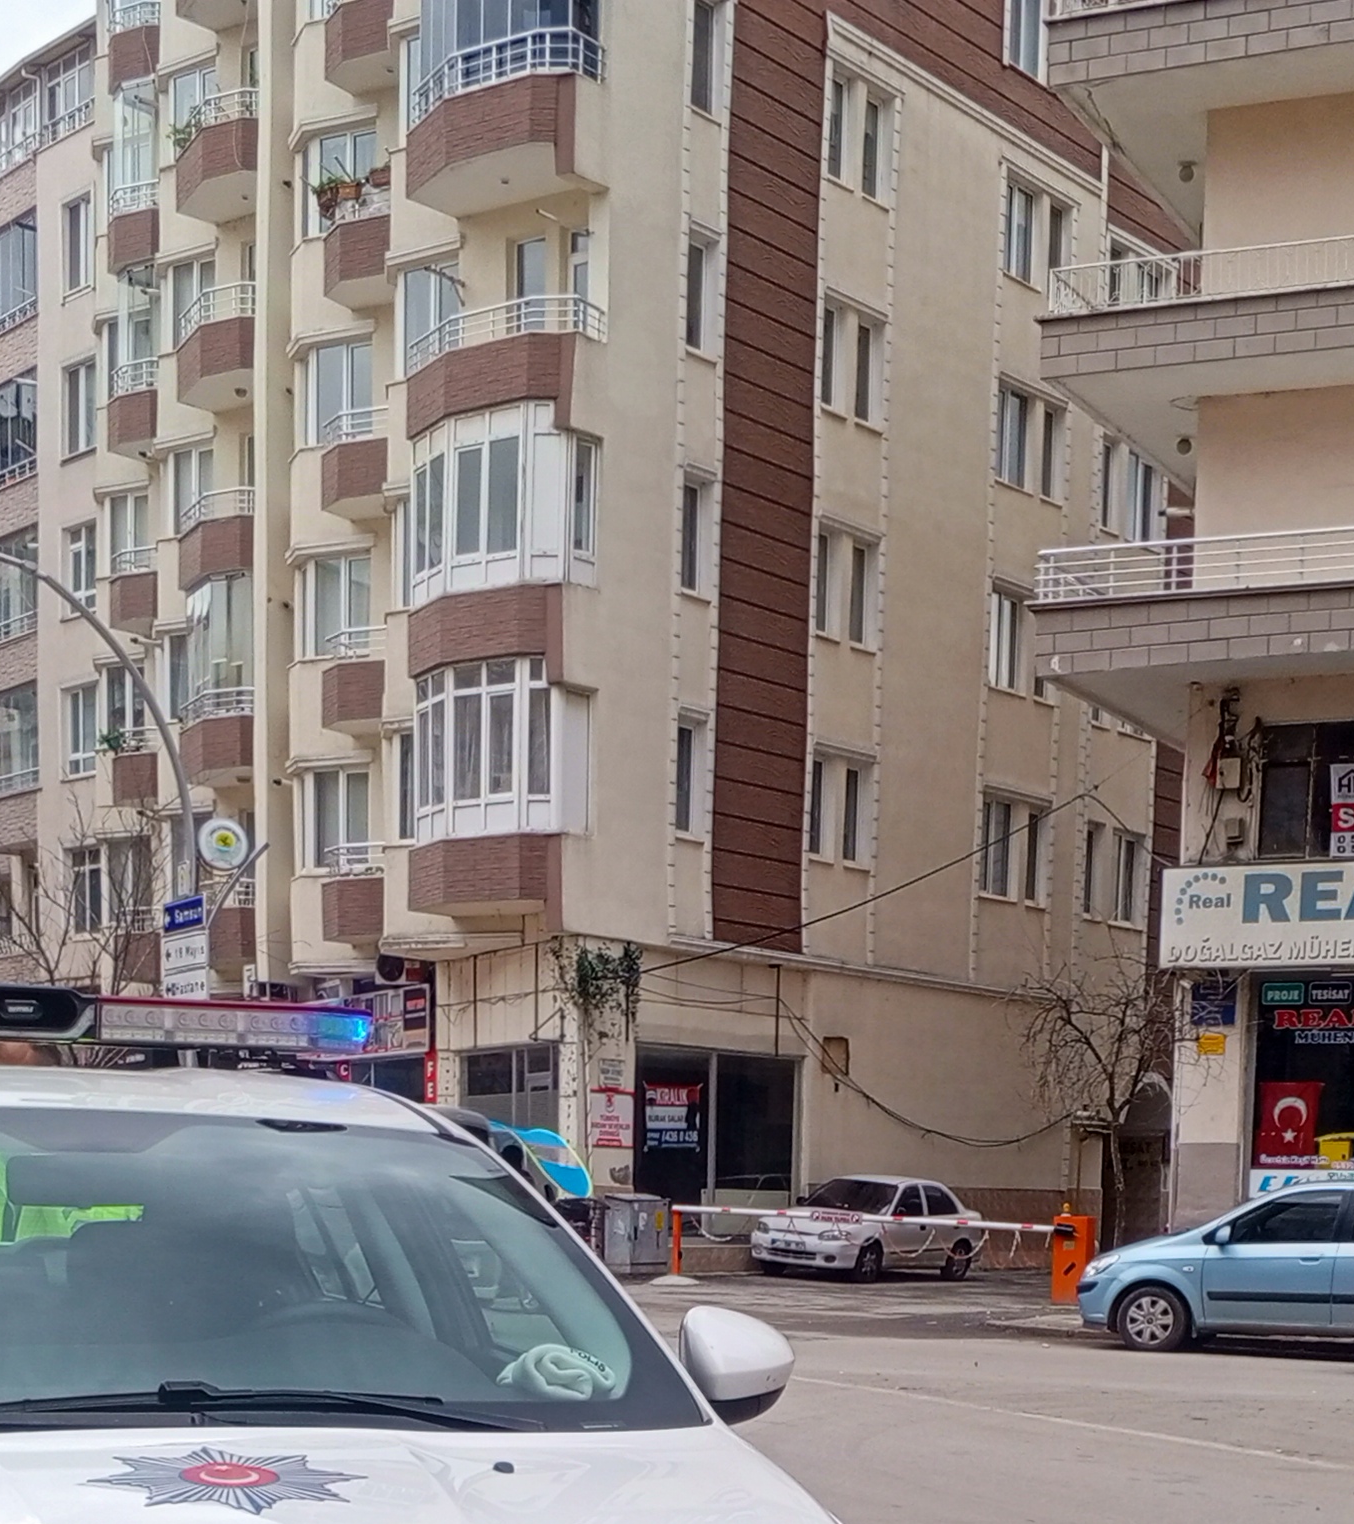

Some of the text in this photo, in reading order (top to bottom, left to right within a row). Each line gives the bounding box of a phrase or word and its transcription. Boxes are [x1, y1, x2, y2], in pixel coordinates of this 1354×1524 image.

[1337, 834, 1346, 844] 0
[1337, 845, 1346, 854] 0
[1188, 893, 1232, 909] Real
[174, 908, 203, 924] Samsun
[1167, 935, 1284, 964] DOĞALGAZ
[1267, 989, 1300, 1001] PROJE
[1311, 987, 1350, 1000] TESİSAT
[656, 1088, 689, 1106] KIRALIK
